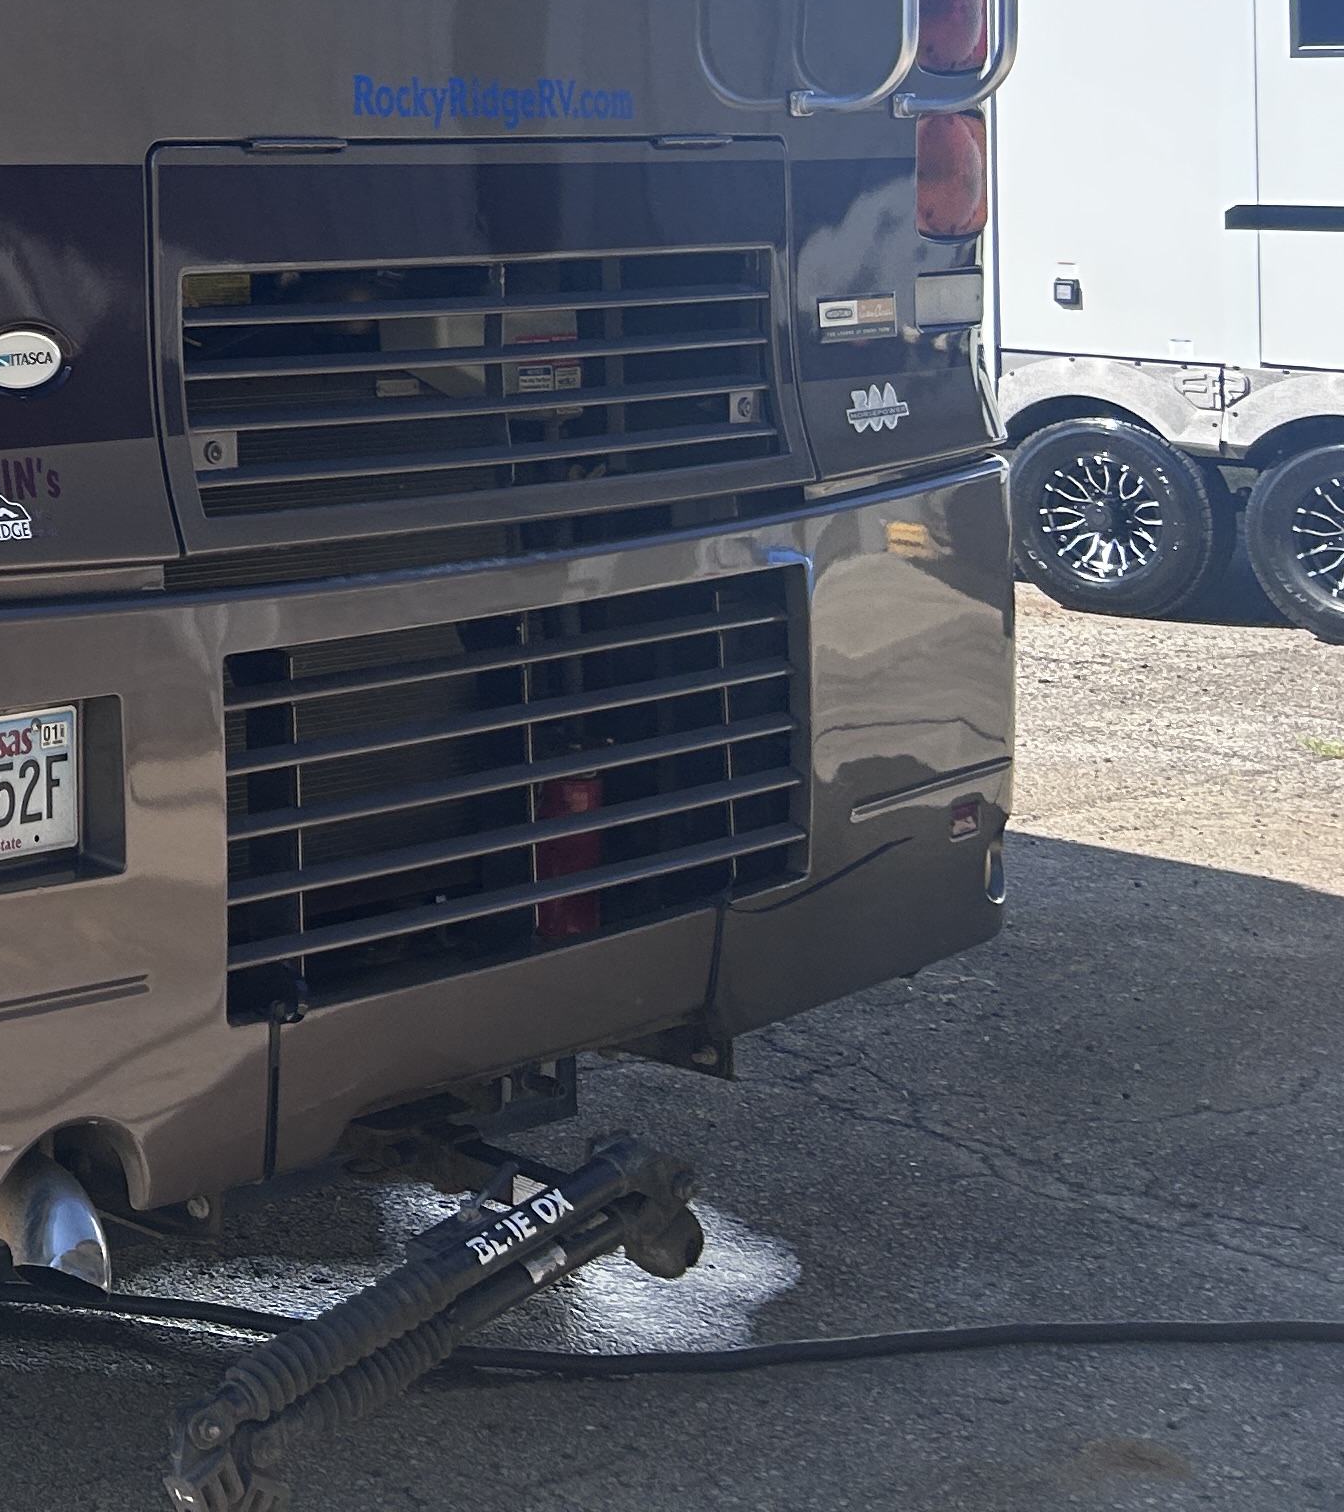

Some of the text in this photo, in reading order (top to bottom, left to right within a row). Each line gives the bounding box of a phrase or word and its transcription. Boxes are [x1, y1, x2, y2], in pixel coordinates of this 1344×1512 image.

[352, 74, 635, 130] RockyRidgeRV.com
[10, 351, 53, 366] ITASCA
[530, 1188, 575, 1224] OX
